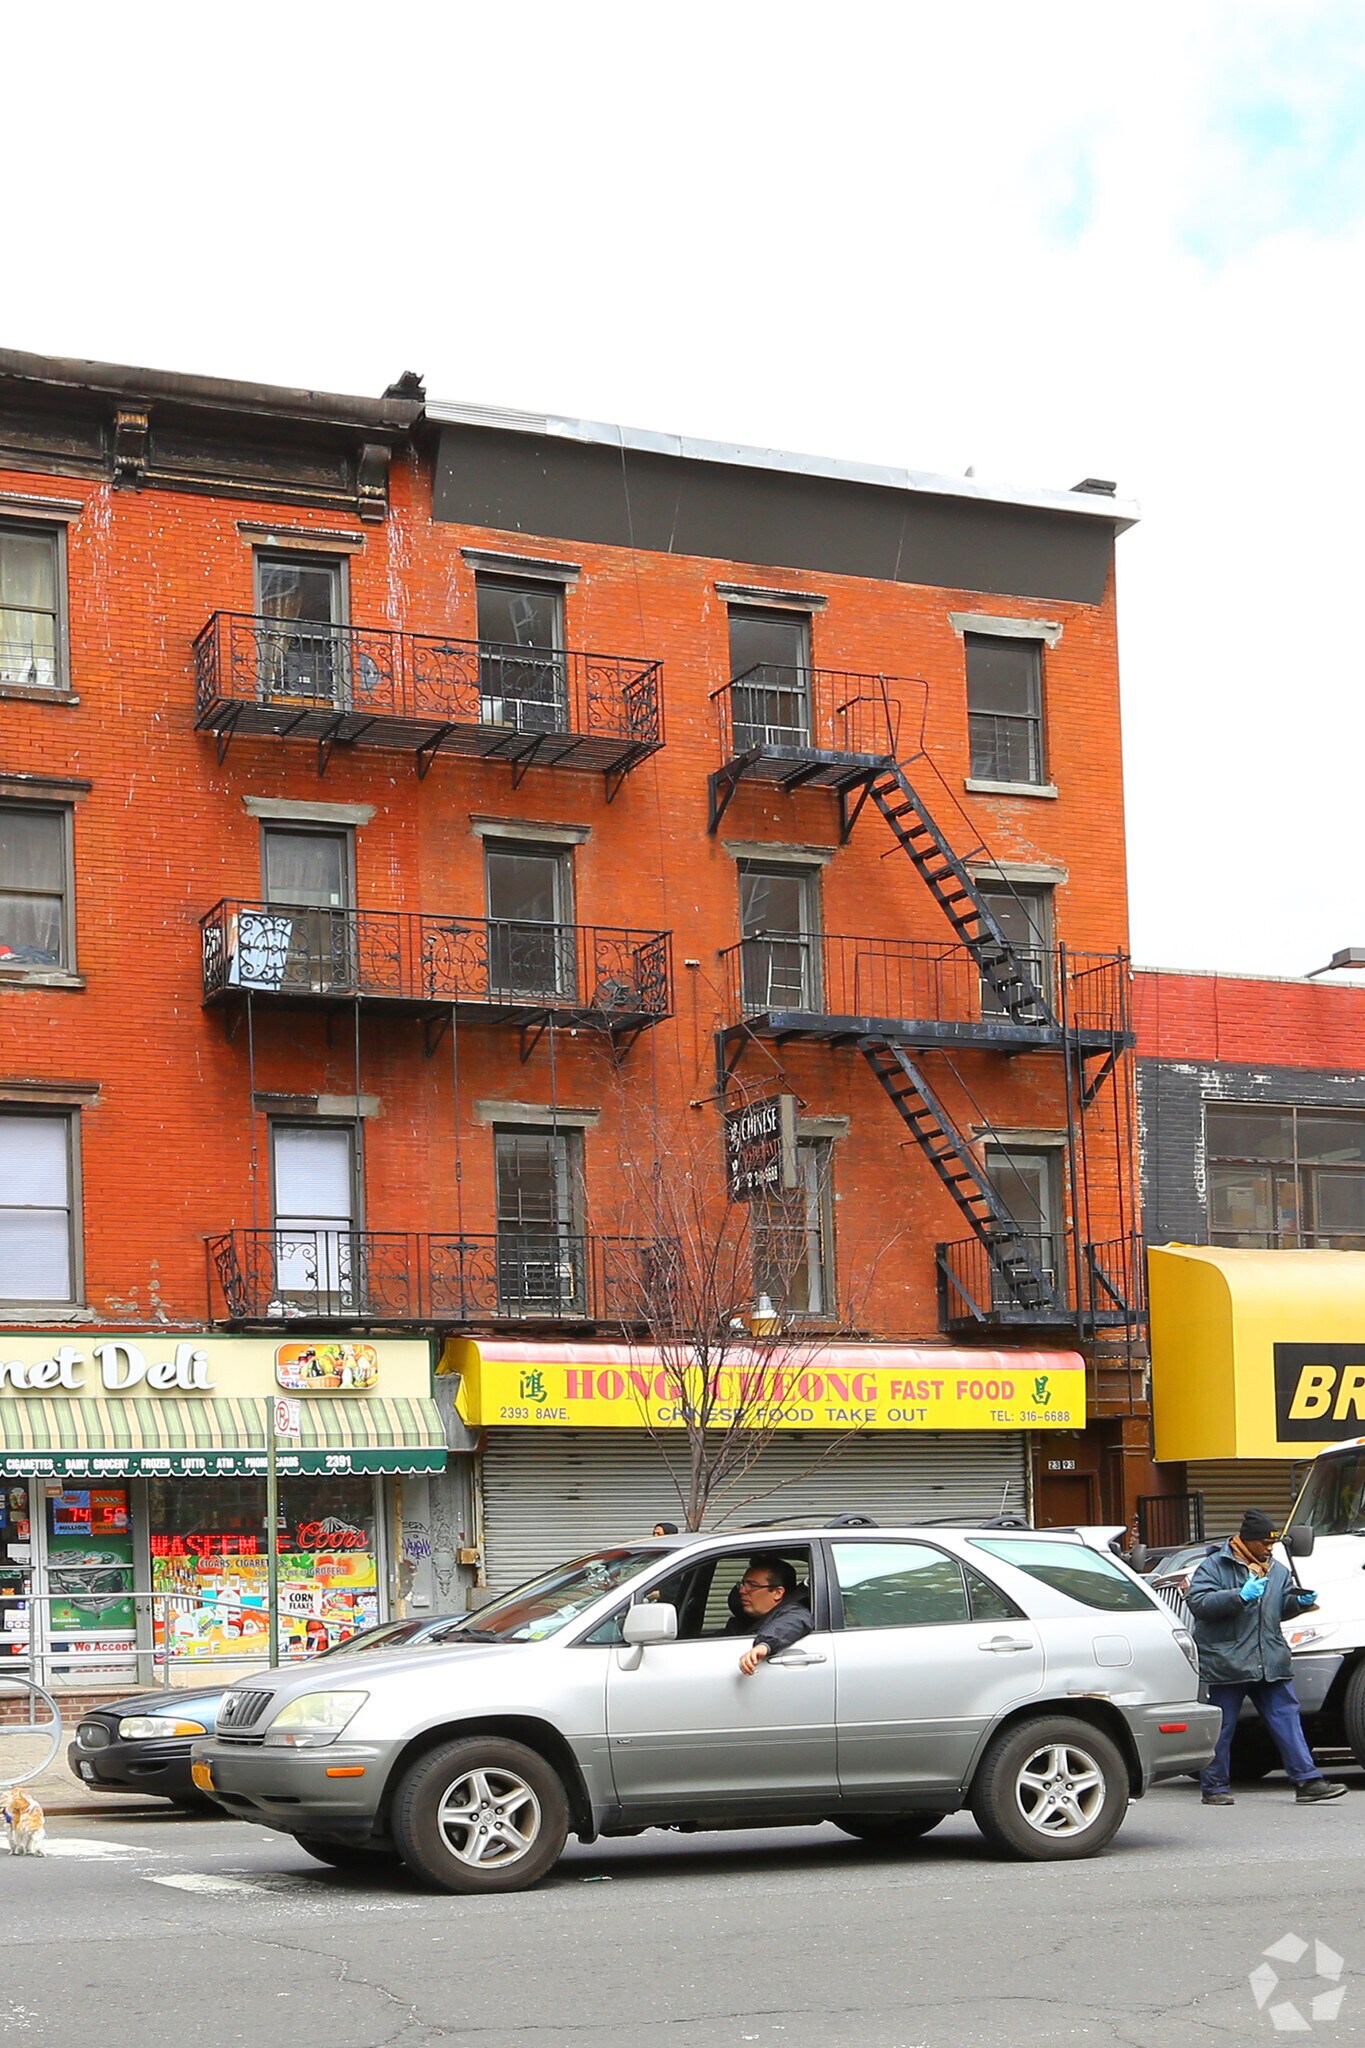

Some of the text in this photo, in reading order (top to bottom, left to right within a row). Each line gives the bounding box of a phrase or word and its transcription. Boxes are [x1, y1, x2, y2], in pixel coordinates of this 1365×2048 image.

[93, 1342, 217, 1390] Deli
[563, 1369, 1015, 1402] HONG CHEONG FAST FOOD
[500, 1407, 570, 1420] 2393 8AVE.
[657, 1407, 927, 1422] CHINESE FOOD TAKE OUT
[990, 1410, 1070, 1422] TEL: 316-6688
[6, 1459, 53, 1470] CIGARETTES
[65, 1459, 90, 1469] DAIRY
[93, 1459, 129, 1469] GROCERY
[141, 1458, 171, 1469] FROZEN
[181, 1458, 205, 1469] LOTTO
[216, 1458, 234, 1468] ATM
[326, 1455, 351, 1467] 2391
[69, 1508, 89, 1522] 74
[296, 1521, 369, 1549] Coors
[200, 1559, 233, 1568] CIGARS,
[310, 1566, 347, 1575] GROCERY
[289, 1593, 314, 1602] CORN
[75, 1642, 133, 1651] We Accept
